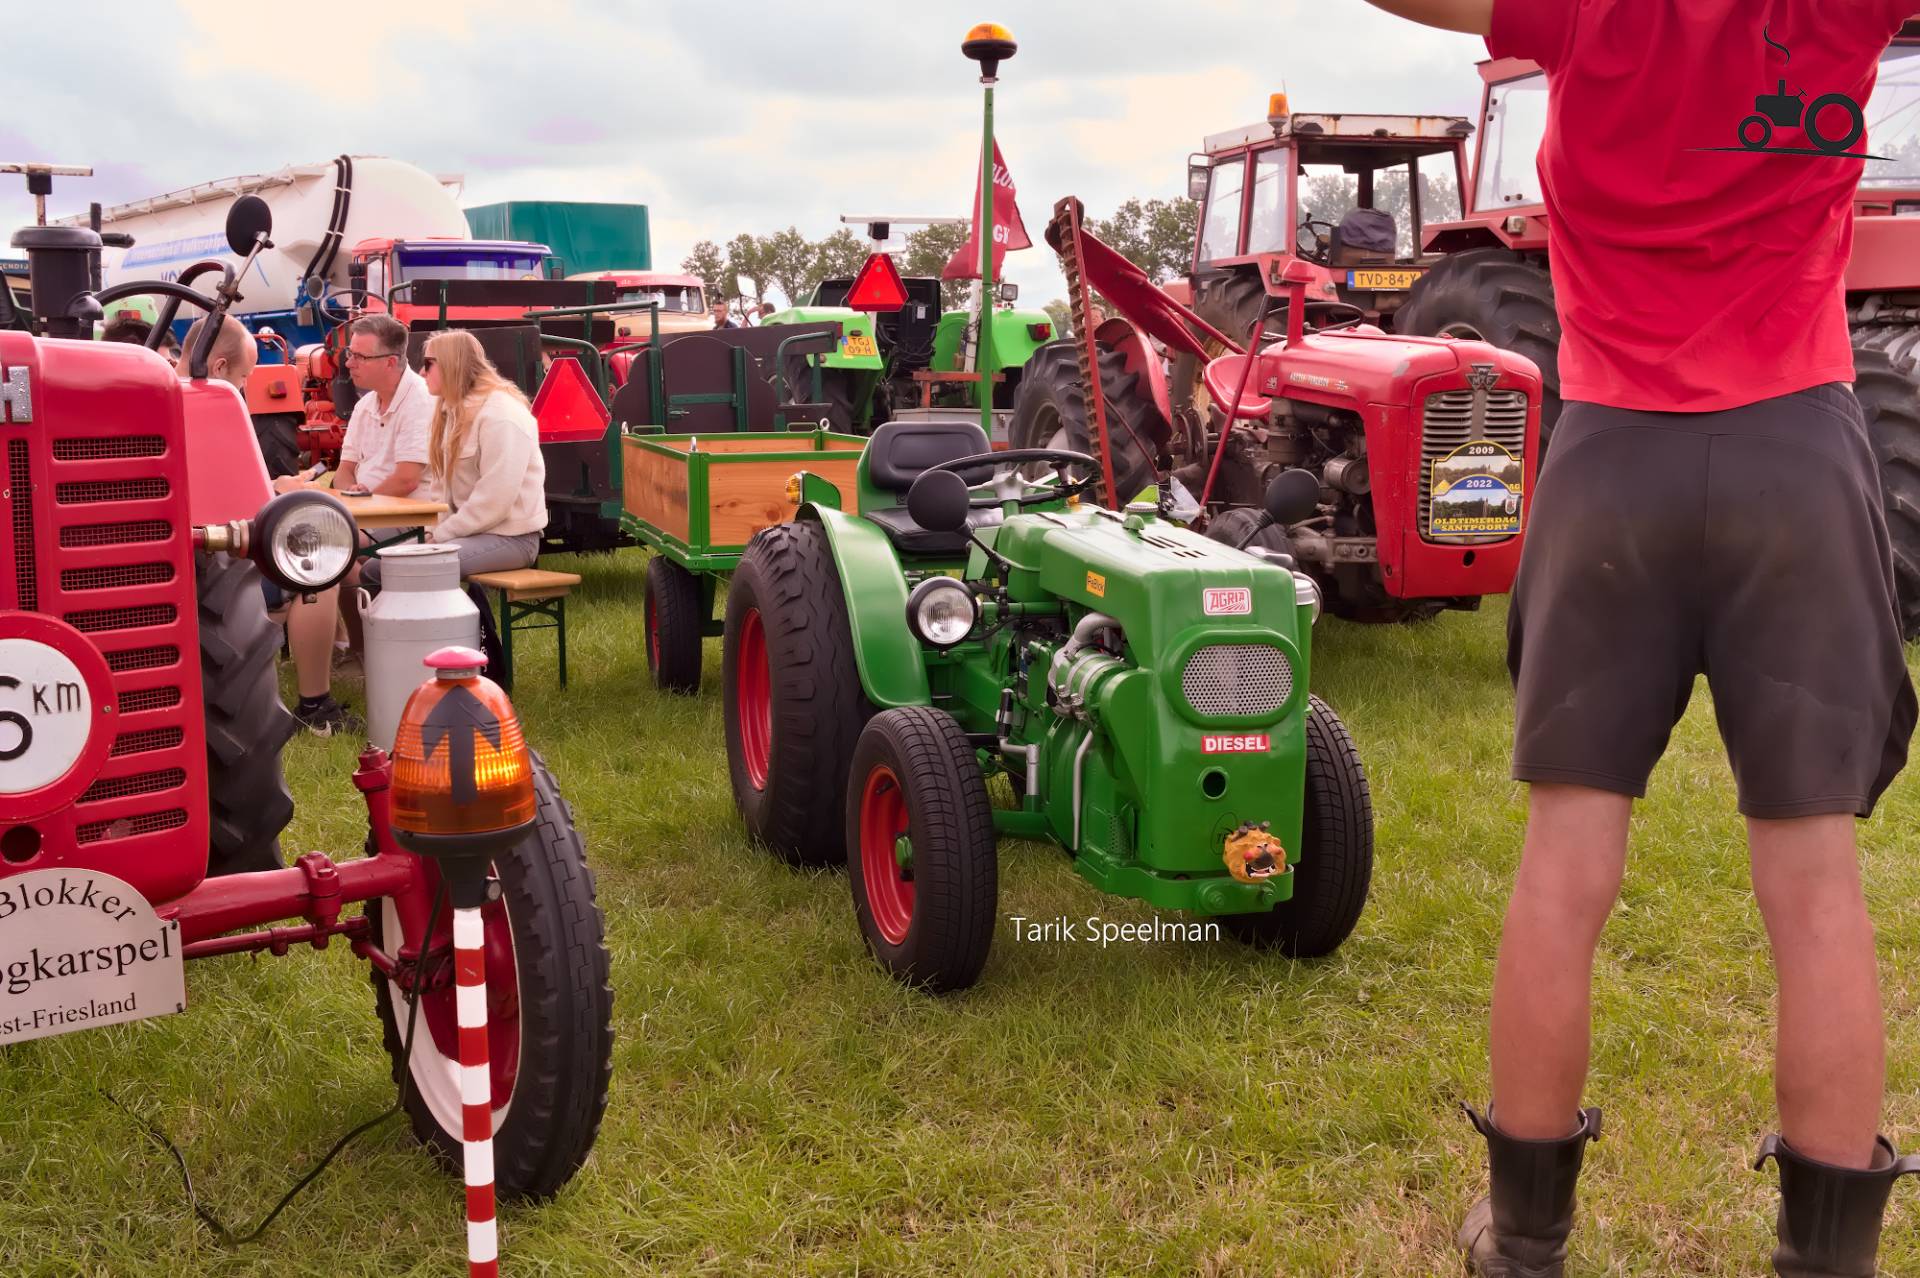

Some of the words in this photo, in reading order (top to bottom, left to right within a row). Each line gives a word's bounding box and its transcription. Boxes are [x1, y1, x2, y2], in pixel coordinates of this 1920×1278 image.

[1468, 446, 1495, 455] 2009
[1466, 479, 1493, 489] 2022
[1433, 516, 1518, 525] OLDTIMERDAG
[1440, 523, 1510, 532] SANTPOORT
[1209, 591, 1246, 610] AGRIA
[1204, 737, 1267, 752] DIESEL
[0, 877, 137, 923] Blokker
[0, 926, 172, 995] gkarspel
[0, 992, 137, 1036] st-Friesland
